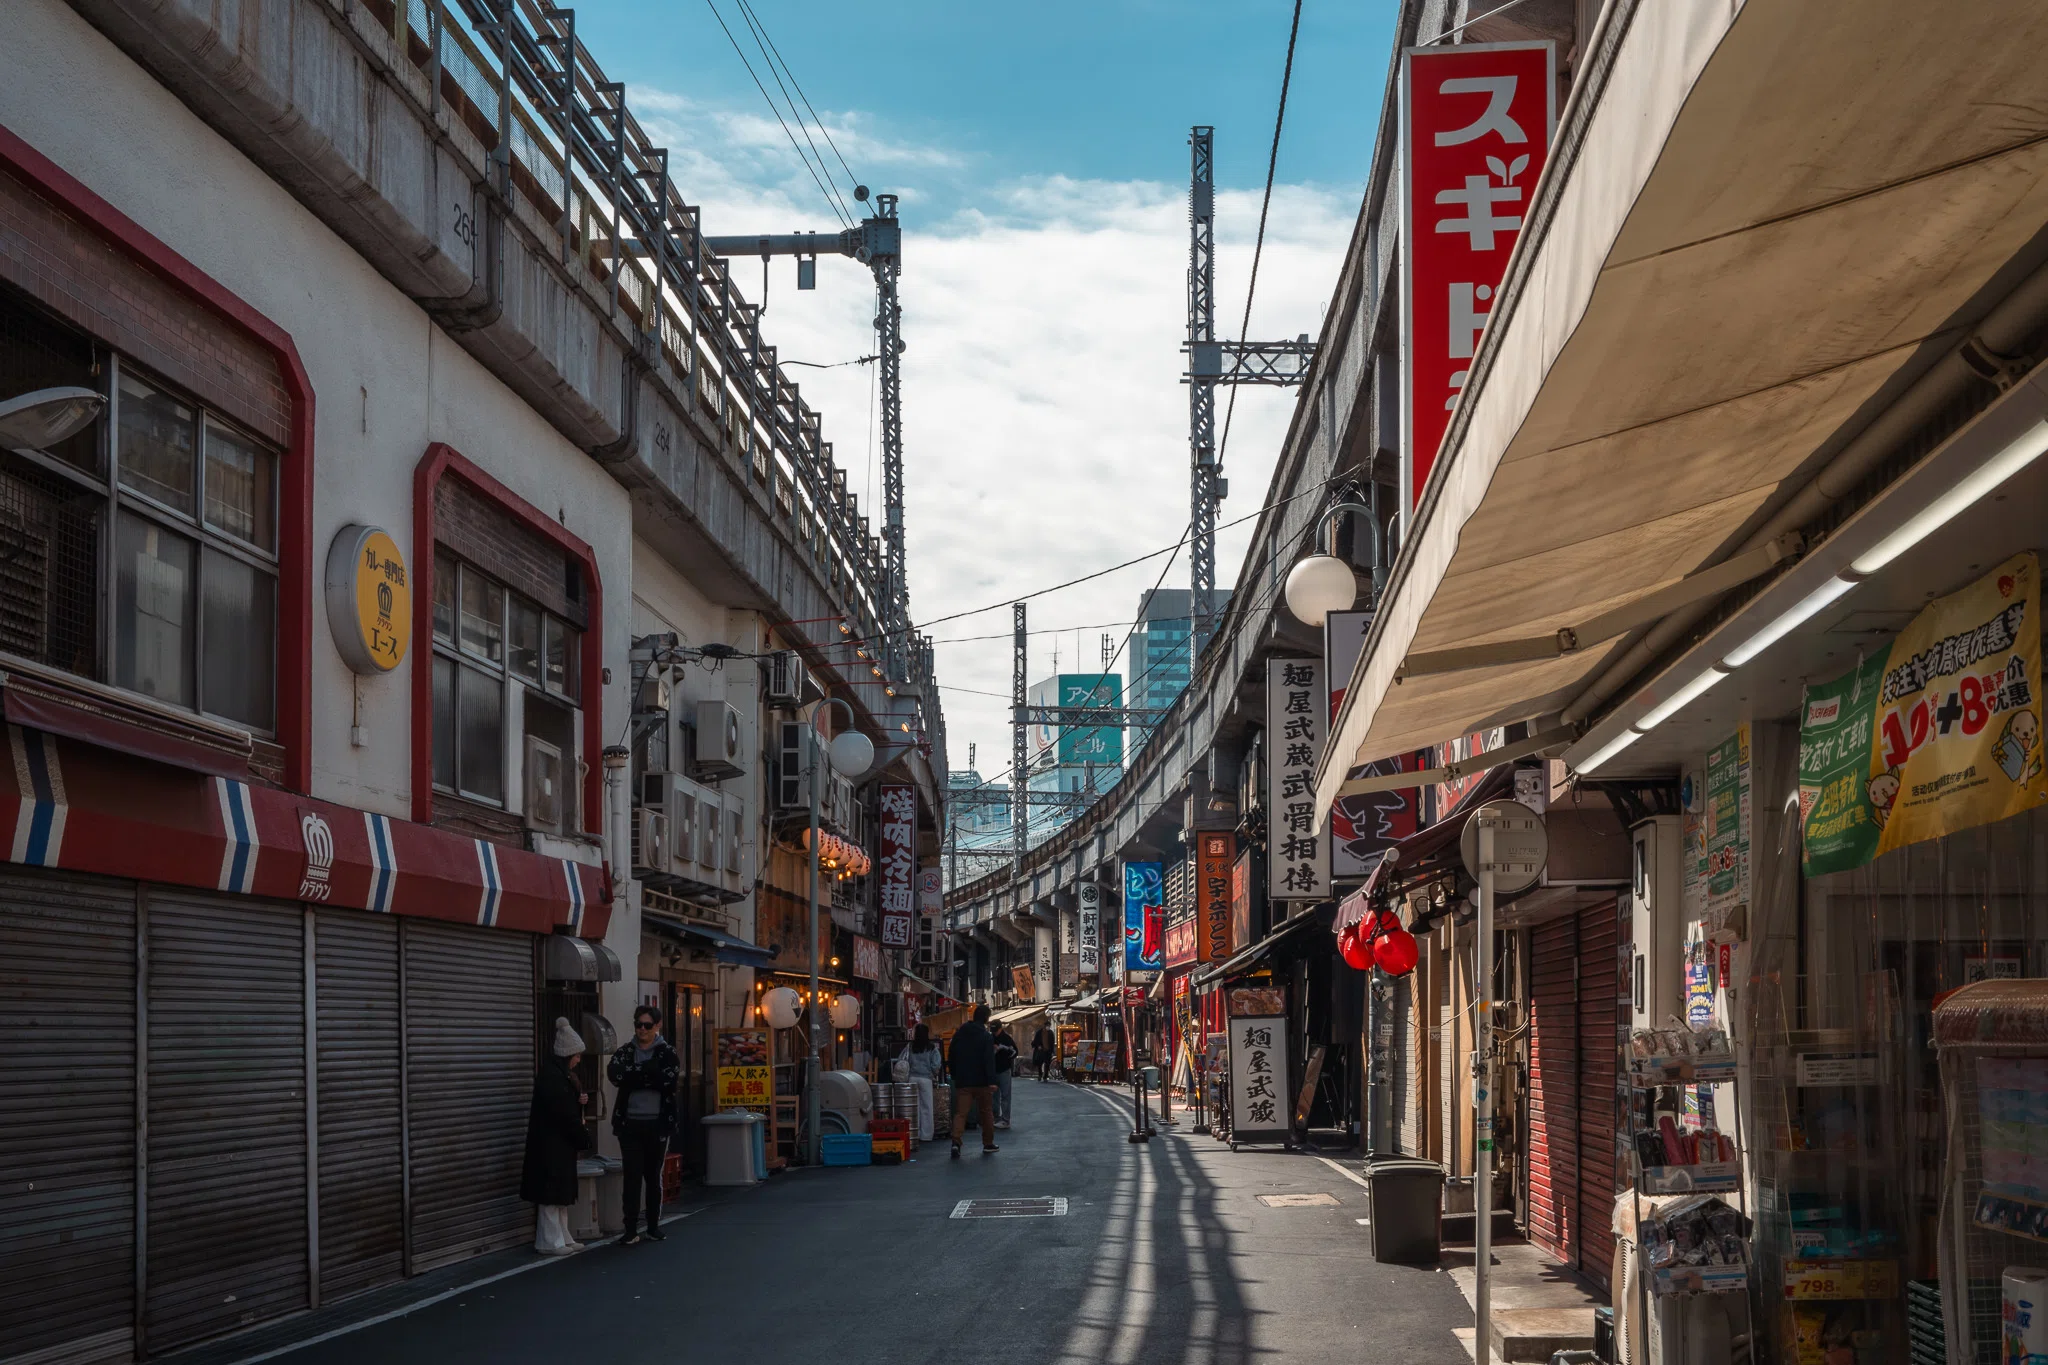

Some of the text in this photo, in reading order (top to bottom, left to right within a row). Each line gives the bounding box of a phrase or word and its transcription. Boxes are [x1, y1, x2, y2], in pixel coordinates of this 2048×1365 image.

[656, 422, 672, 456] 264
[366, 547, 405, 588] カレー専門店
[371, 627, 397, 659] エース
[300, 879, 332, 901] クラウン
[1207, 877, 1228, 959] 宇奈とと
[720, 1068, 769, 1080] 一人飲み
[726, 1081, 764, 1096] 最強
[1242, 1027, 1277, 1124] 麺屋武蔵
